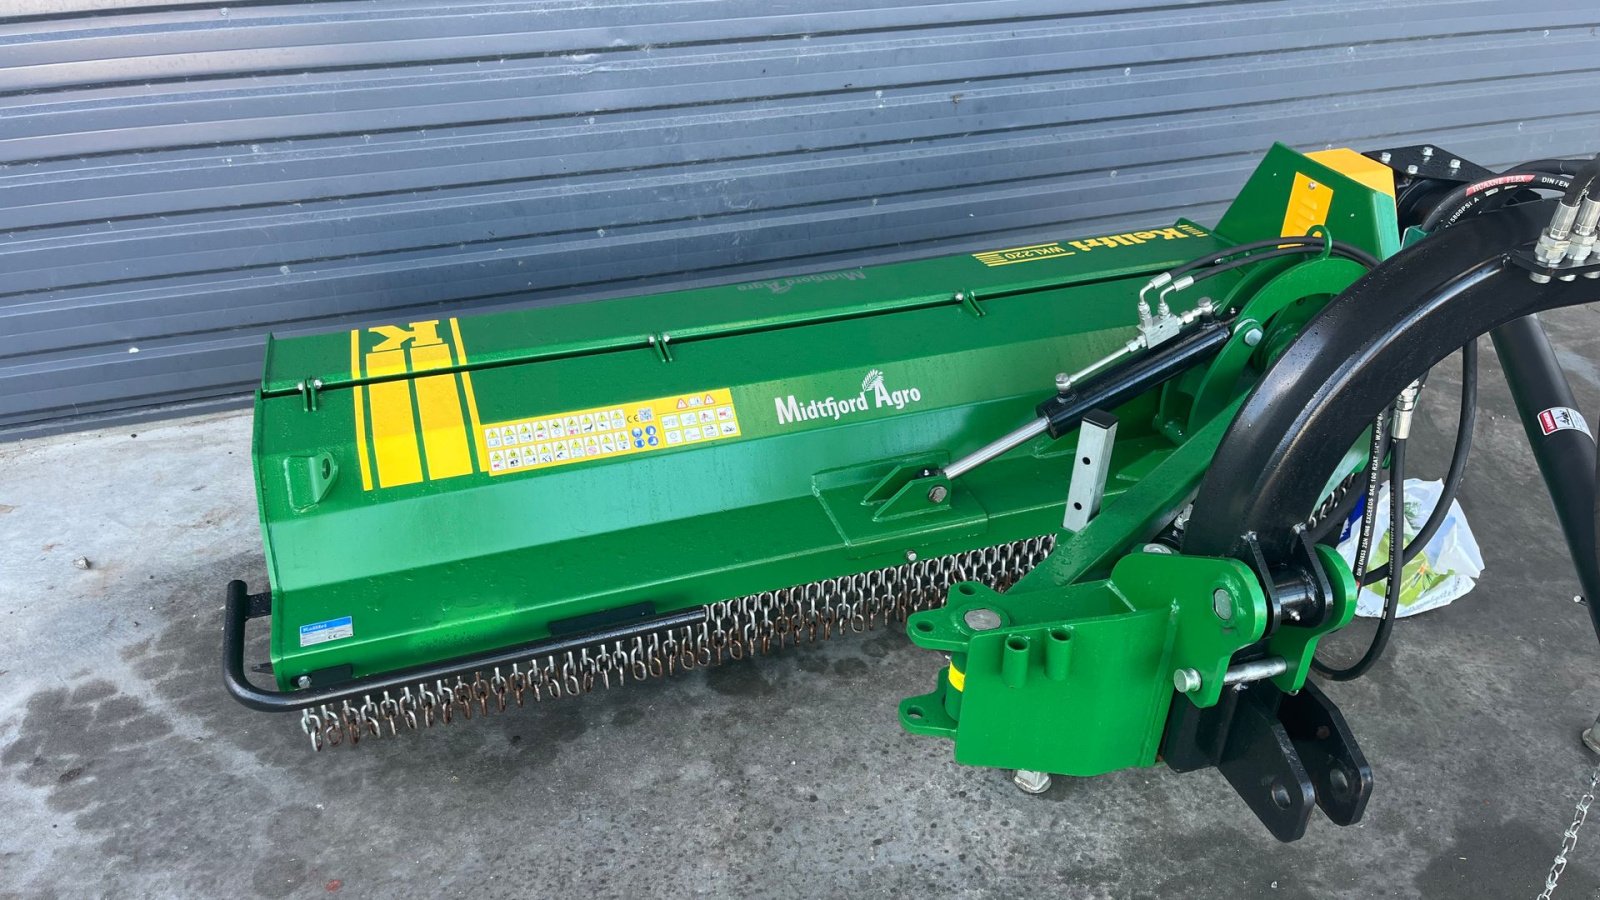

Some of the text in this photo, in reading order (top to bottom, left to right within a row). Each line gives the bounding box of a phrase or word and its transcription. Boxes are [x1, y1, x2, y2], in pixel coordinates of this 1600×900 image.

[1506, 174, 1525, 183] FLEX
[1068, 227, 1189, 252] Kellfri
[1004, 245, 1066, 260] WKL220
[774, 379, 921, 425] Midtfjord Agro
[1368, 484, 1376, 497] SAE
[1365, 497, 1374, 524] EXCEEDS
